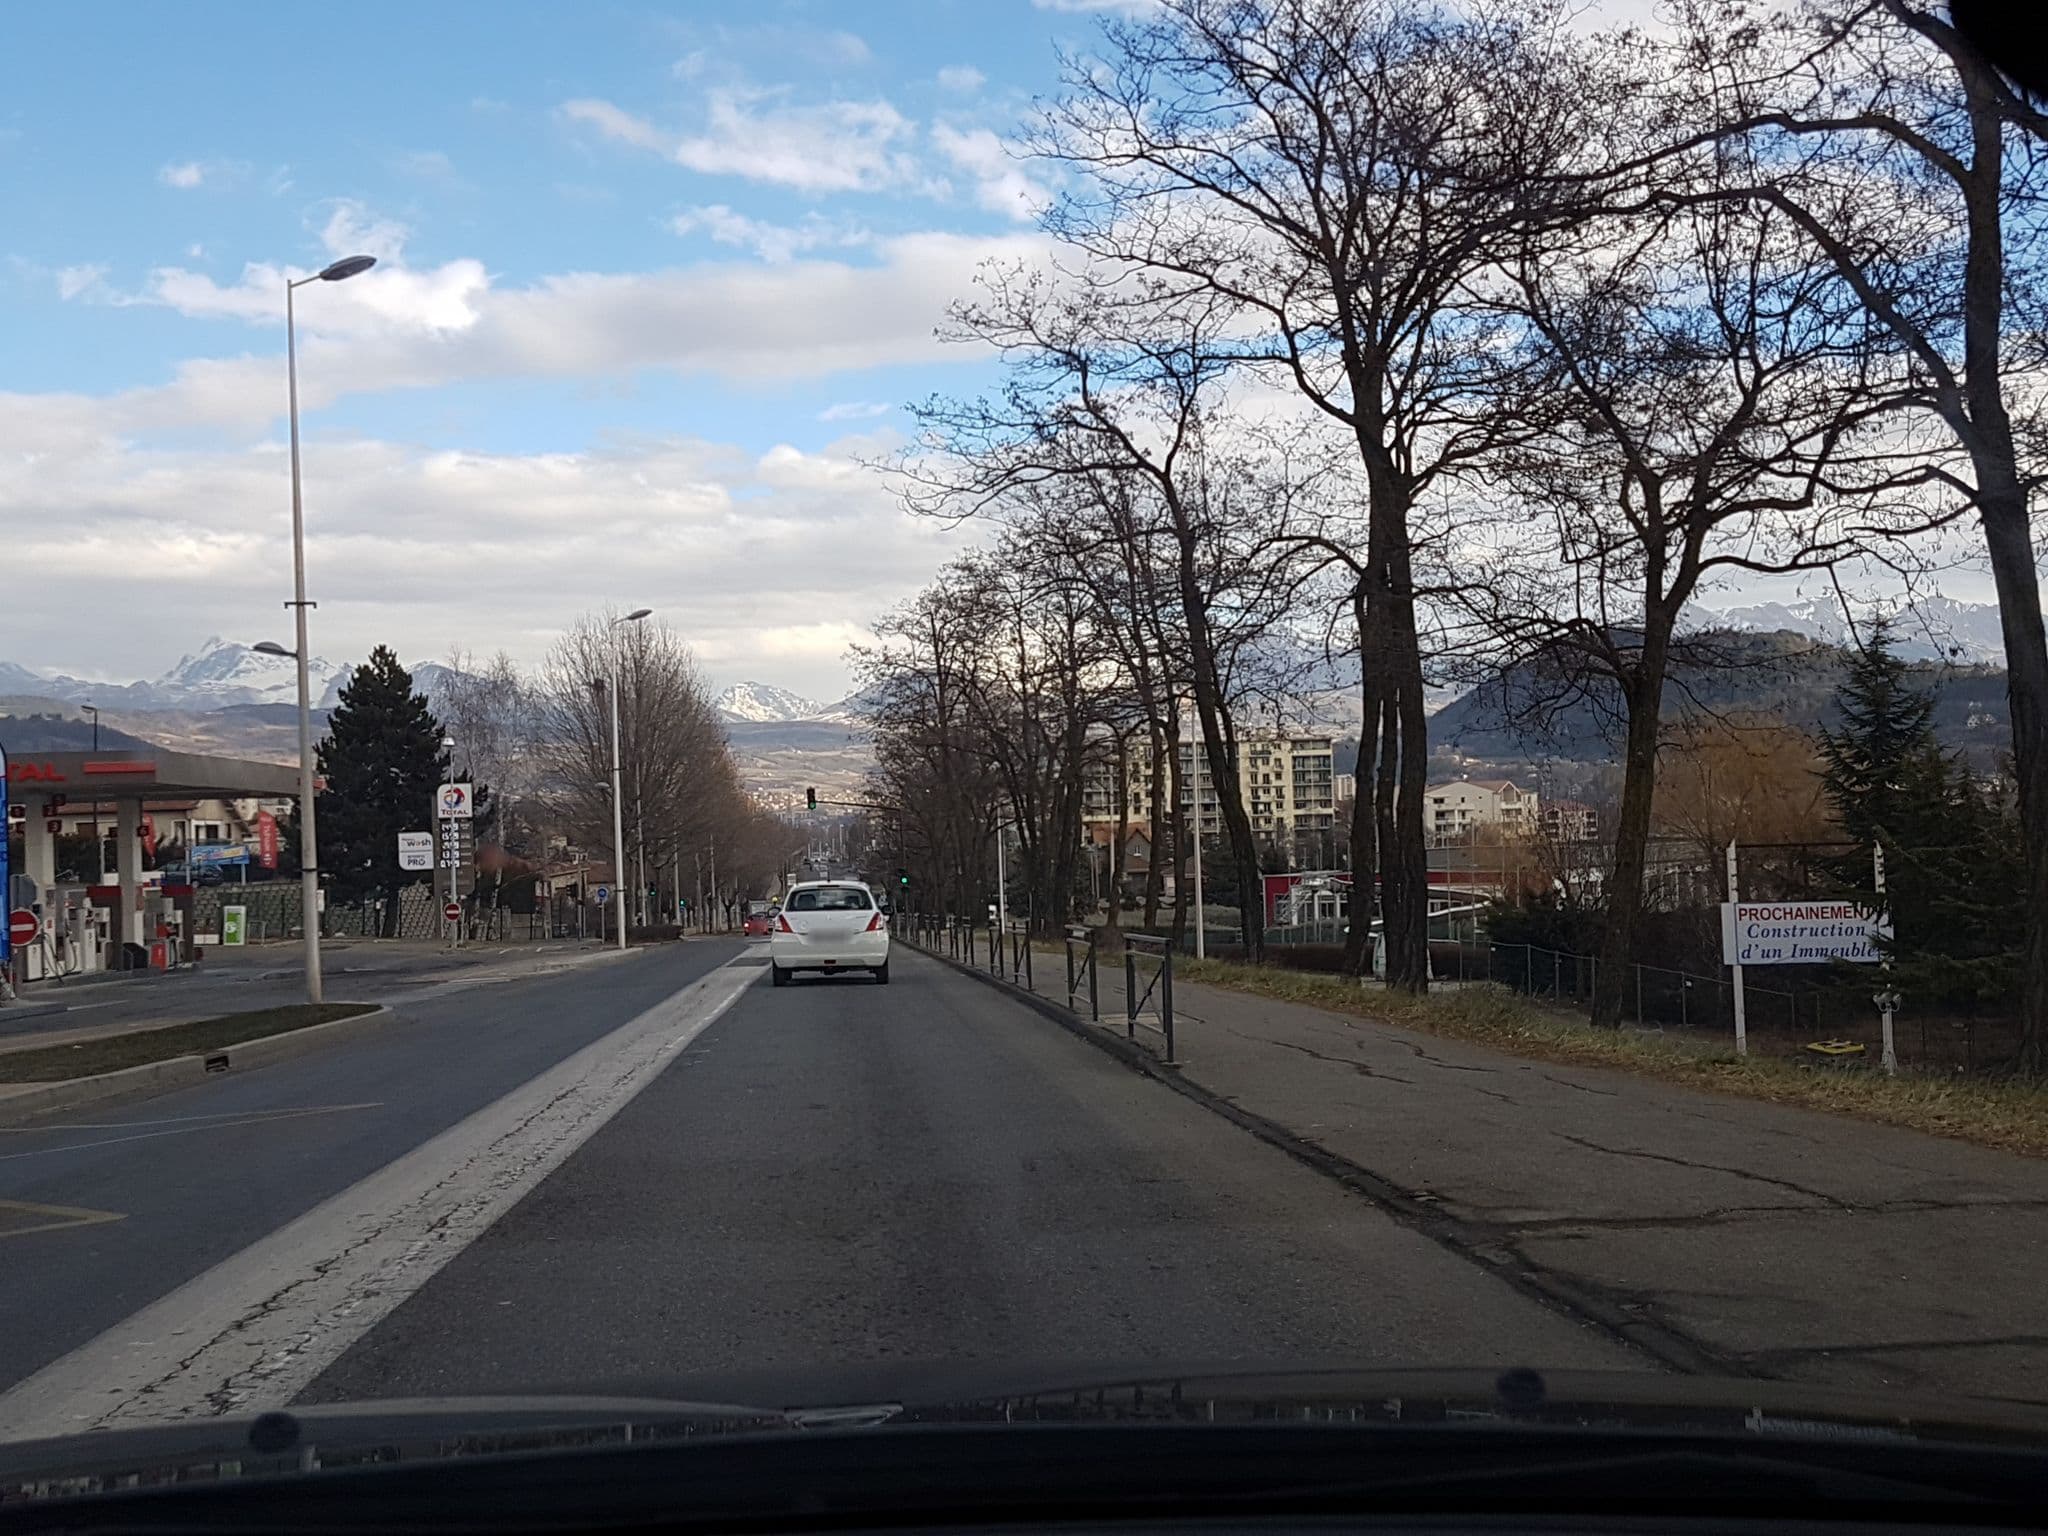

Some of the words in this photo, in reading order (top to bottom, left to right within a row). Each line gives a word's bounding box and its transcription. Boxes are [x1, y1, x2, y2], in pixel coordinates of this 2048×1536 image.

[407, 858, 426, 866] PRO
[1747, 923, 1866, 938] Construction
[1791, 943, 1877, 959] Immeuble
